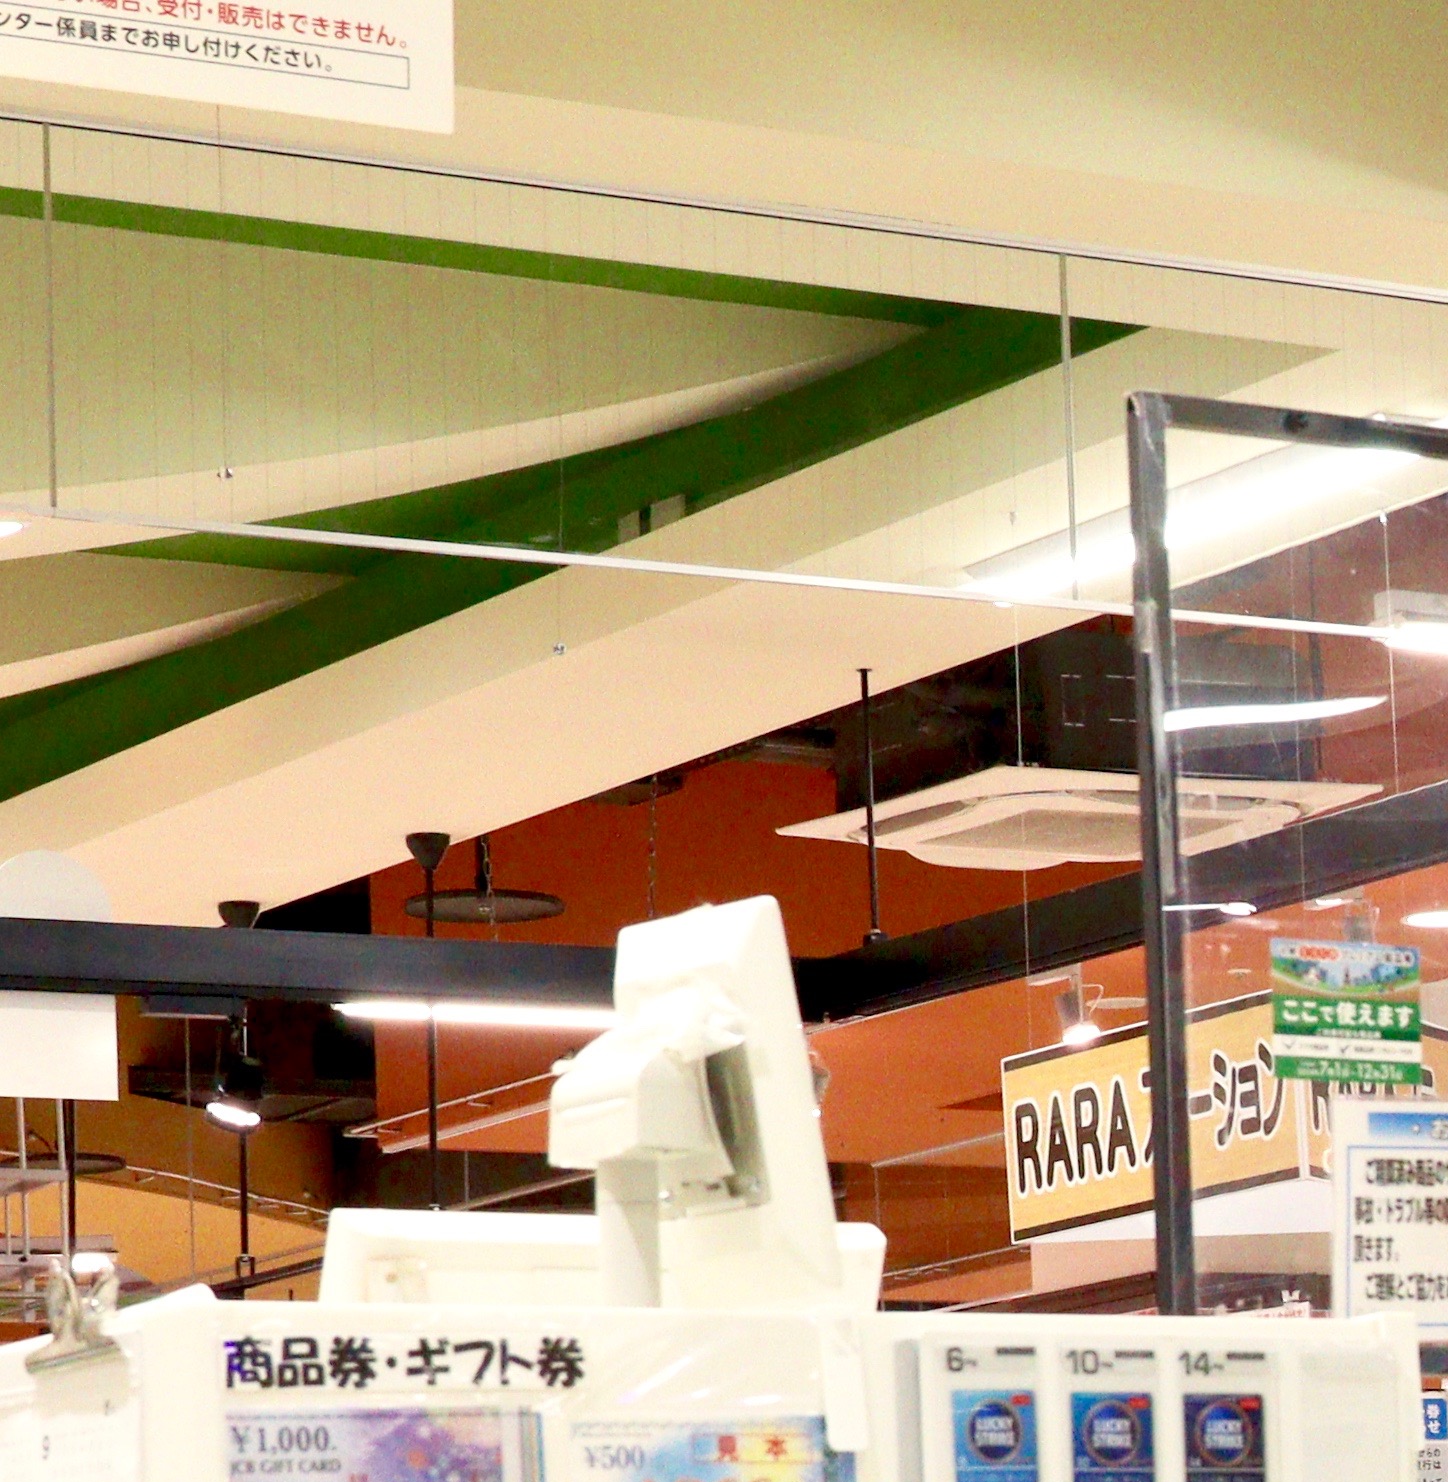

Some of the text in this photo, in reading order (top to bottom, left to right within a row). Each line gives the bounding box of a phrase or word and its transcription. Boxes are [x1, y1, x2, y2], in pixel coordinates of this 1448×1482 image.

[1281, 999, 1414, 1029] ここで使えます
[225, 1336, 586, 1390] 商品券・ギフト券
[298, 1457, 342, 1473] CARD
[584, 1444, 645, 1470] ¥500
